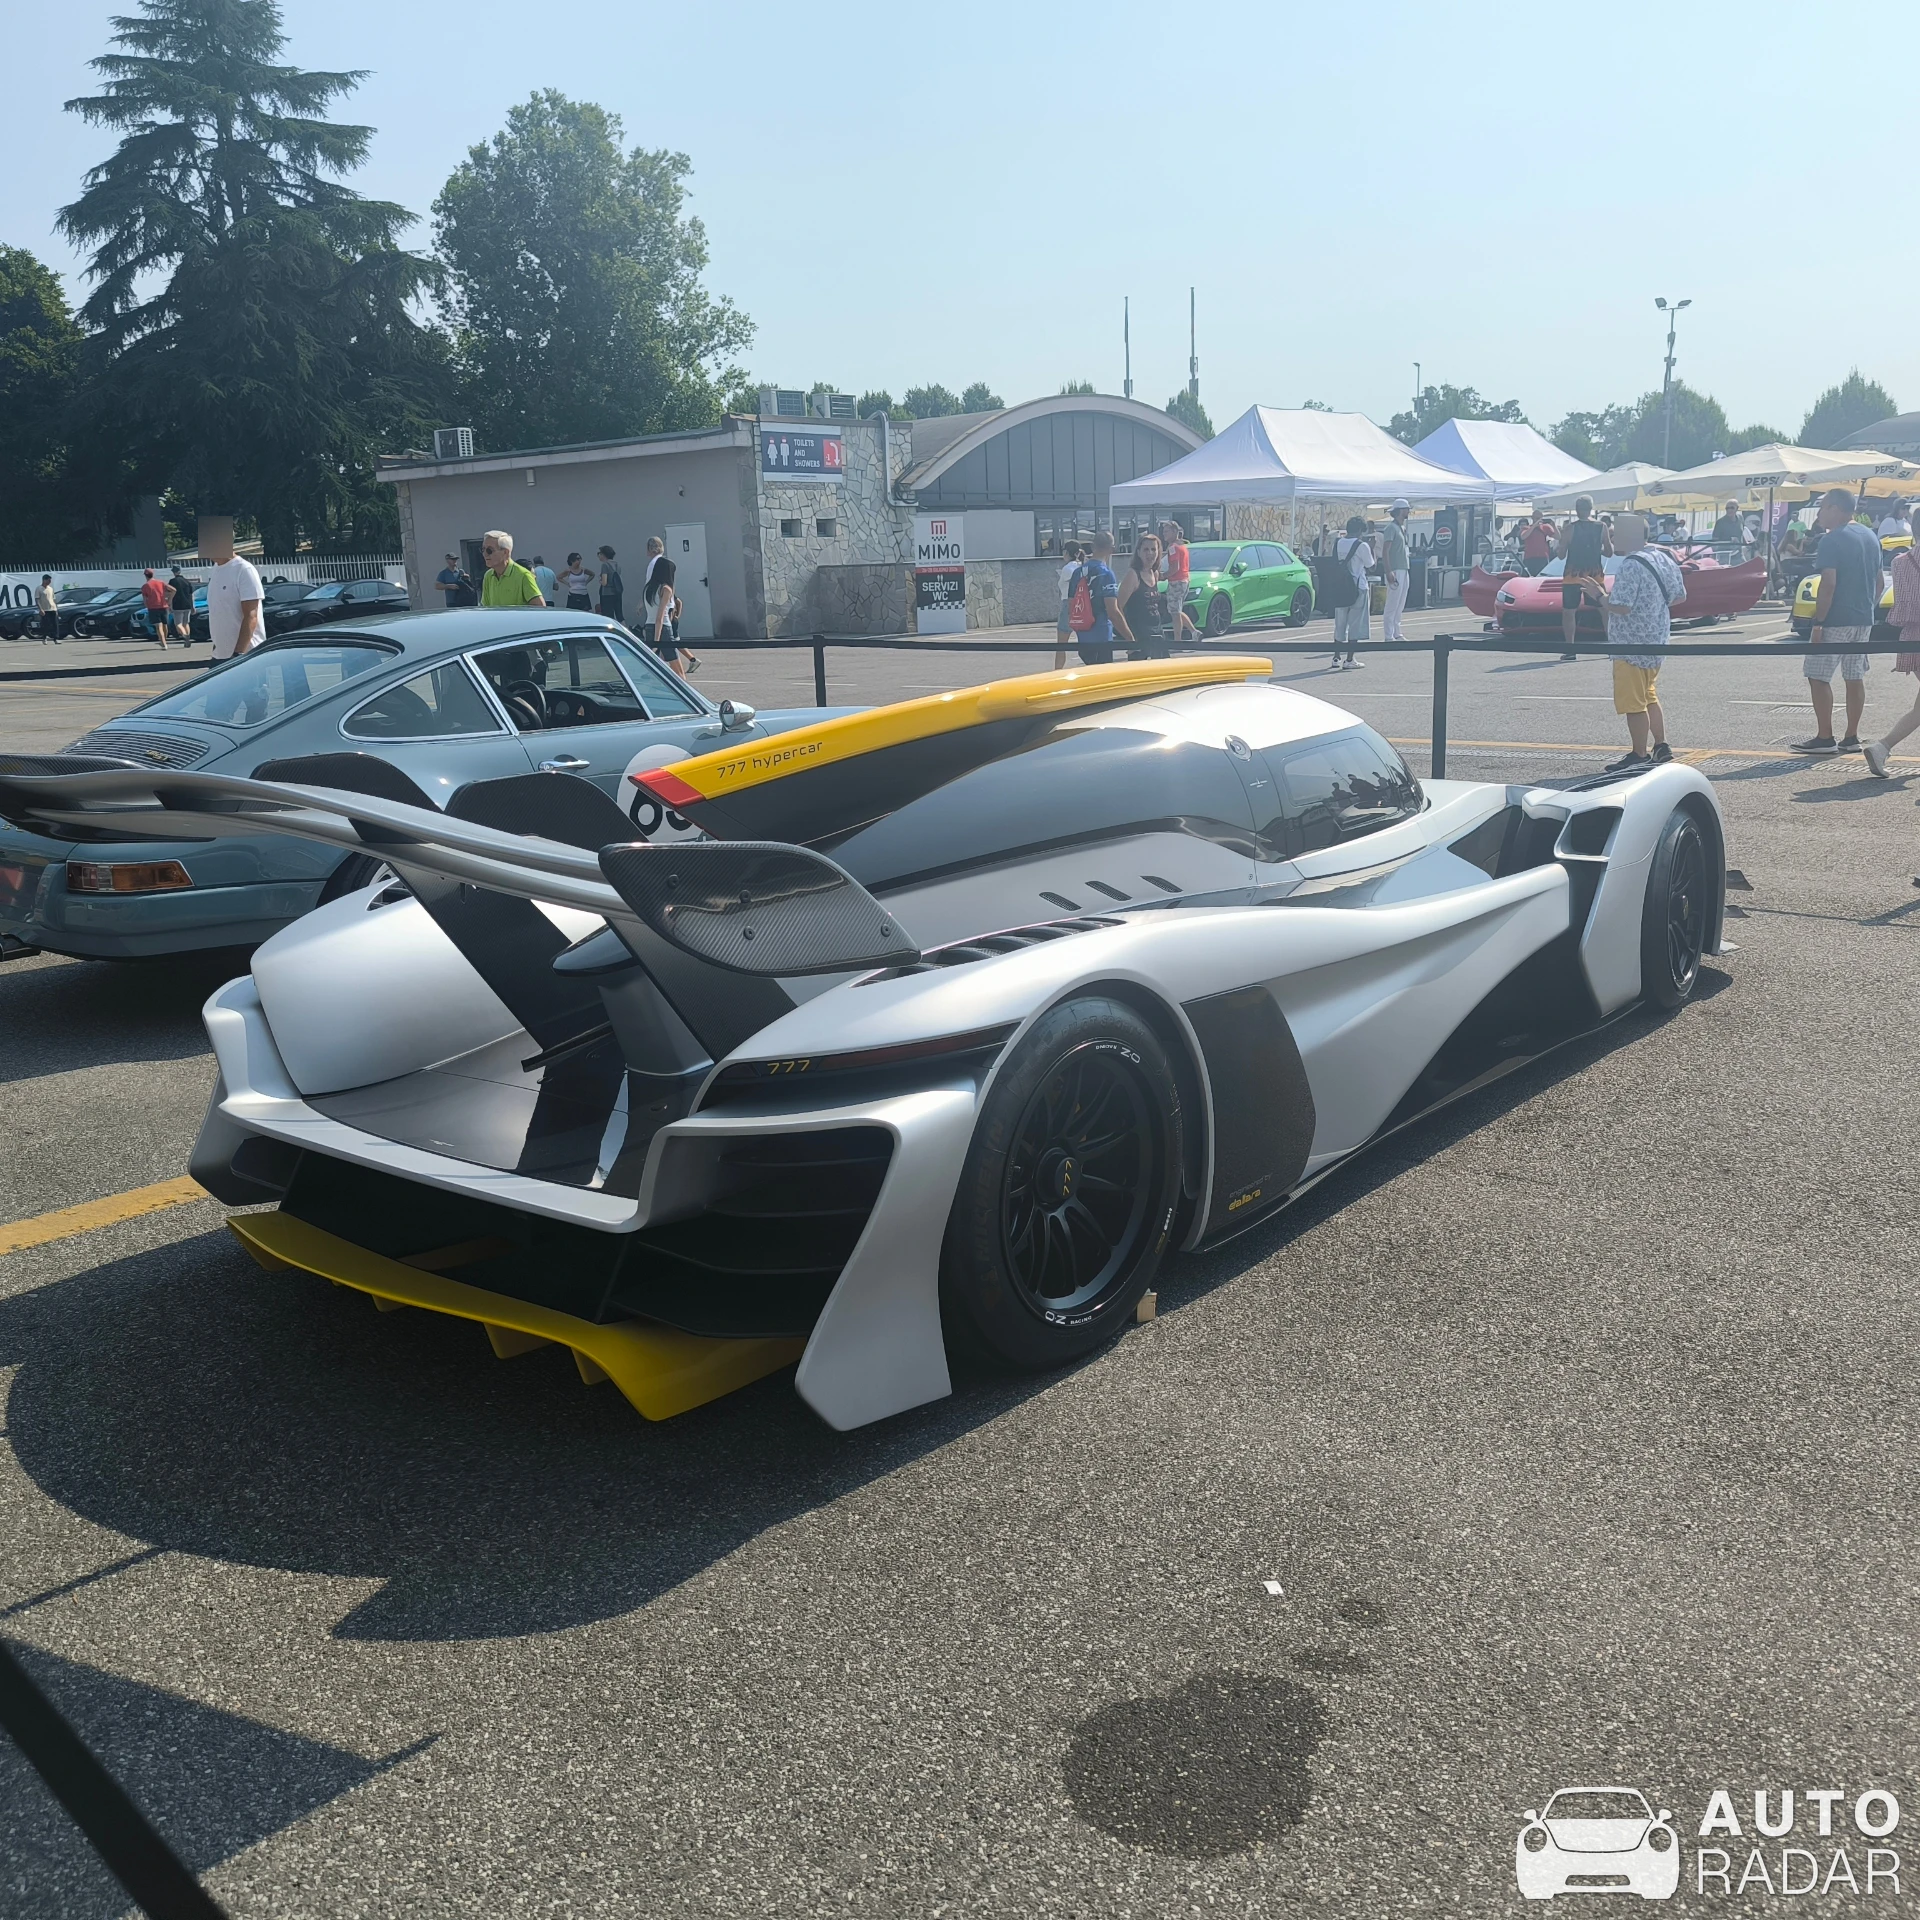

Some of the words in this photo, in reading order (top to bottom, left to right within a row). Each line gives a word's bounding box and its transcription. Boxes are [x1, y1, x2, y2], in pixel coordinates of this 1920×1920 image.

[794, 439, 814, 447] TOILETS
[794, 449, 805, 457] AND
[795, 460, 820, 468] SHOWERS
[1745, 476, 1780, 486] PEPSI
[918, 543, 961, 560] MIMO
[922, 581, 958, 592] SERVIZI
[932, 591, 948, 601] WC
[717, 761, 746, 778] 777
[752, 742, 823, 769] hypercar
[767, 1060, 810, 1075] 777
[1070, 1315, 1092, 1325] RACING
